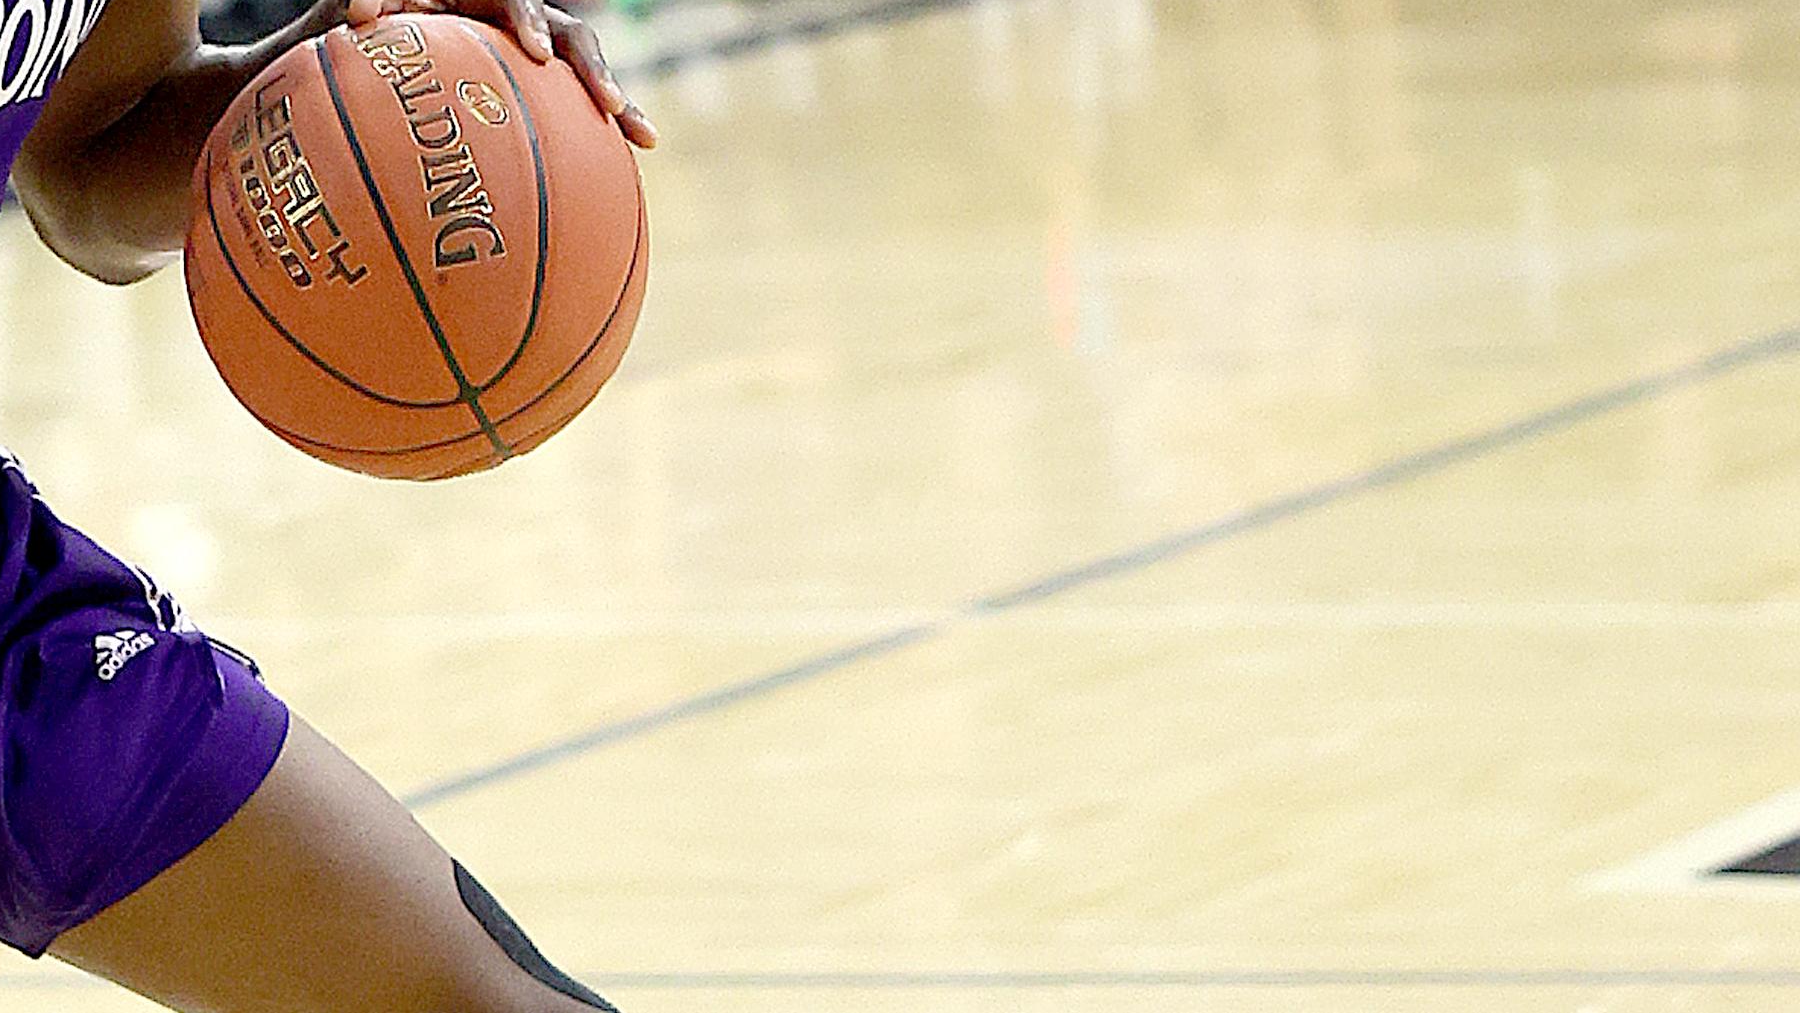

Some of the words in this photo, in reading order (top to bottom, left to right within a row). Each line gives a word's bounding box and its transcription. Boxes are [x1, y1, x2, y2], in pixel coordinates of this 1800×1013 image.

[254, 74, 371, 287] LEGACY
[353, 21, 507, 270] PALDING
[97, 632, 156, 681] adidas
